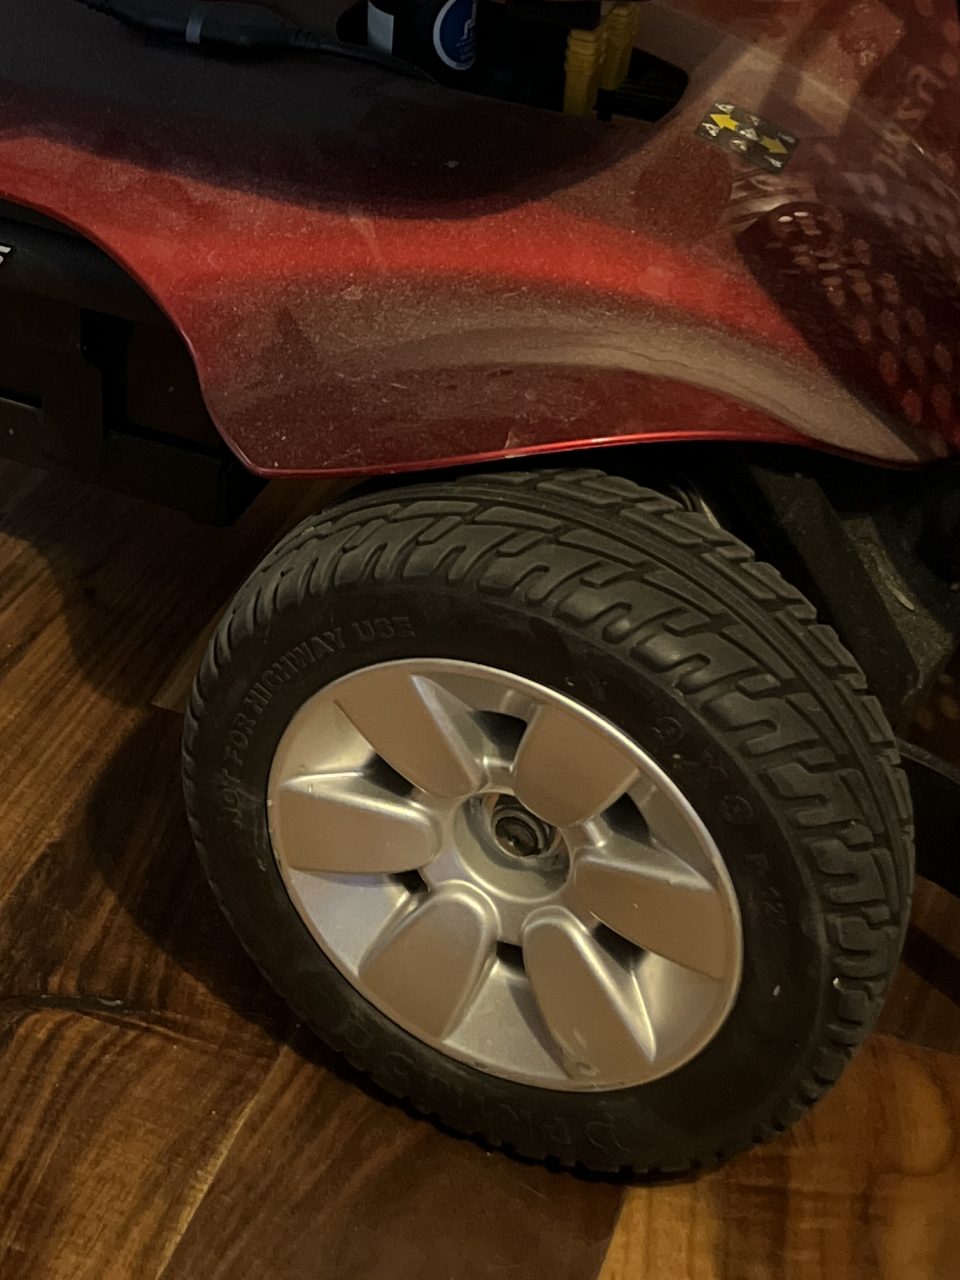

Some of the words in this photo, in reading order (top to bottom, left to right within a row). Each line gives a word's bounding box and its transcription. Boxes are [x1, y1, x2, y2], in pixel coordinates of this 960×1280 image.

[224, 712, 257, 767] FOR
[243, 627, 347, 716] HIGHWAY
[351, 616, 416, 642] USE
